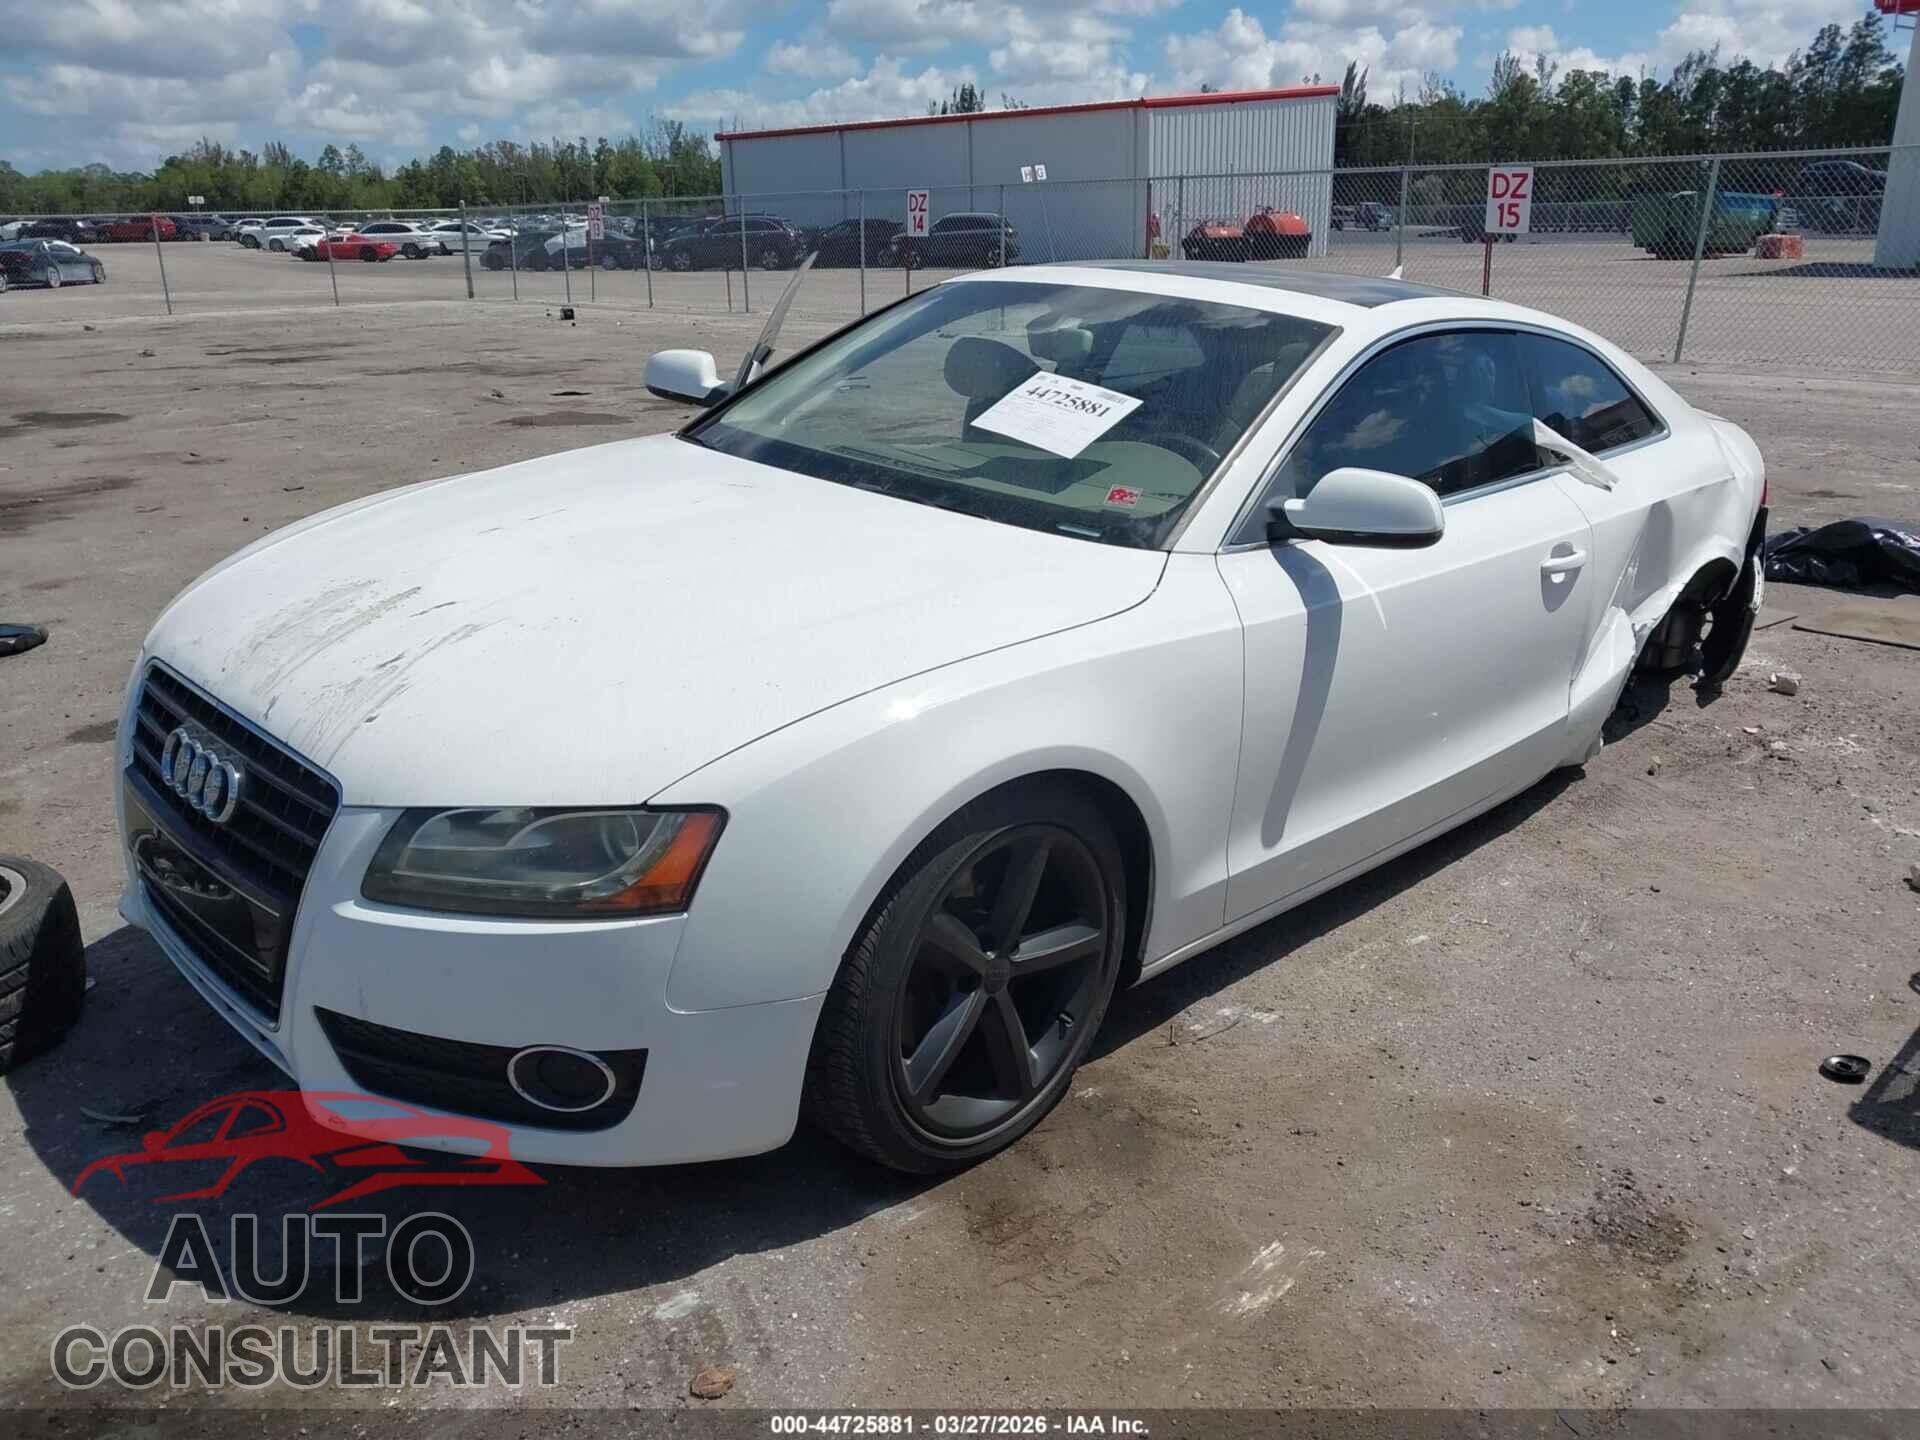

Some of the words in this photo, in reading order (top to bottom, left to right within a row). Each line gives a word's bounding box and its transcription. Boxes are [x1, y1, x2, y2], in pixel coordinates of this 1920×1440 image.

[1492, 173, 1528, 198] DZ
[909, 193, 927, 212] DZ
[912, 215, 924, 232] 14
[1497, 203, 1520, 228] 15
[1026, 386, 1112, 417] 44725881
